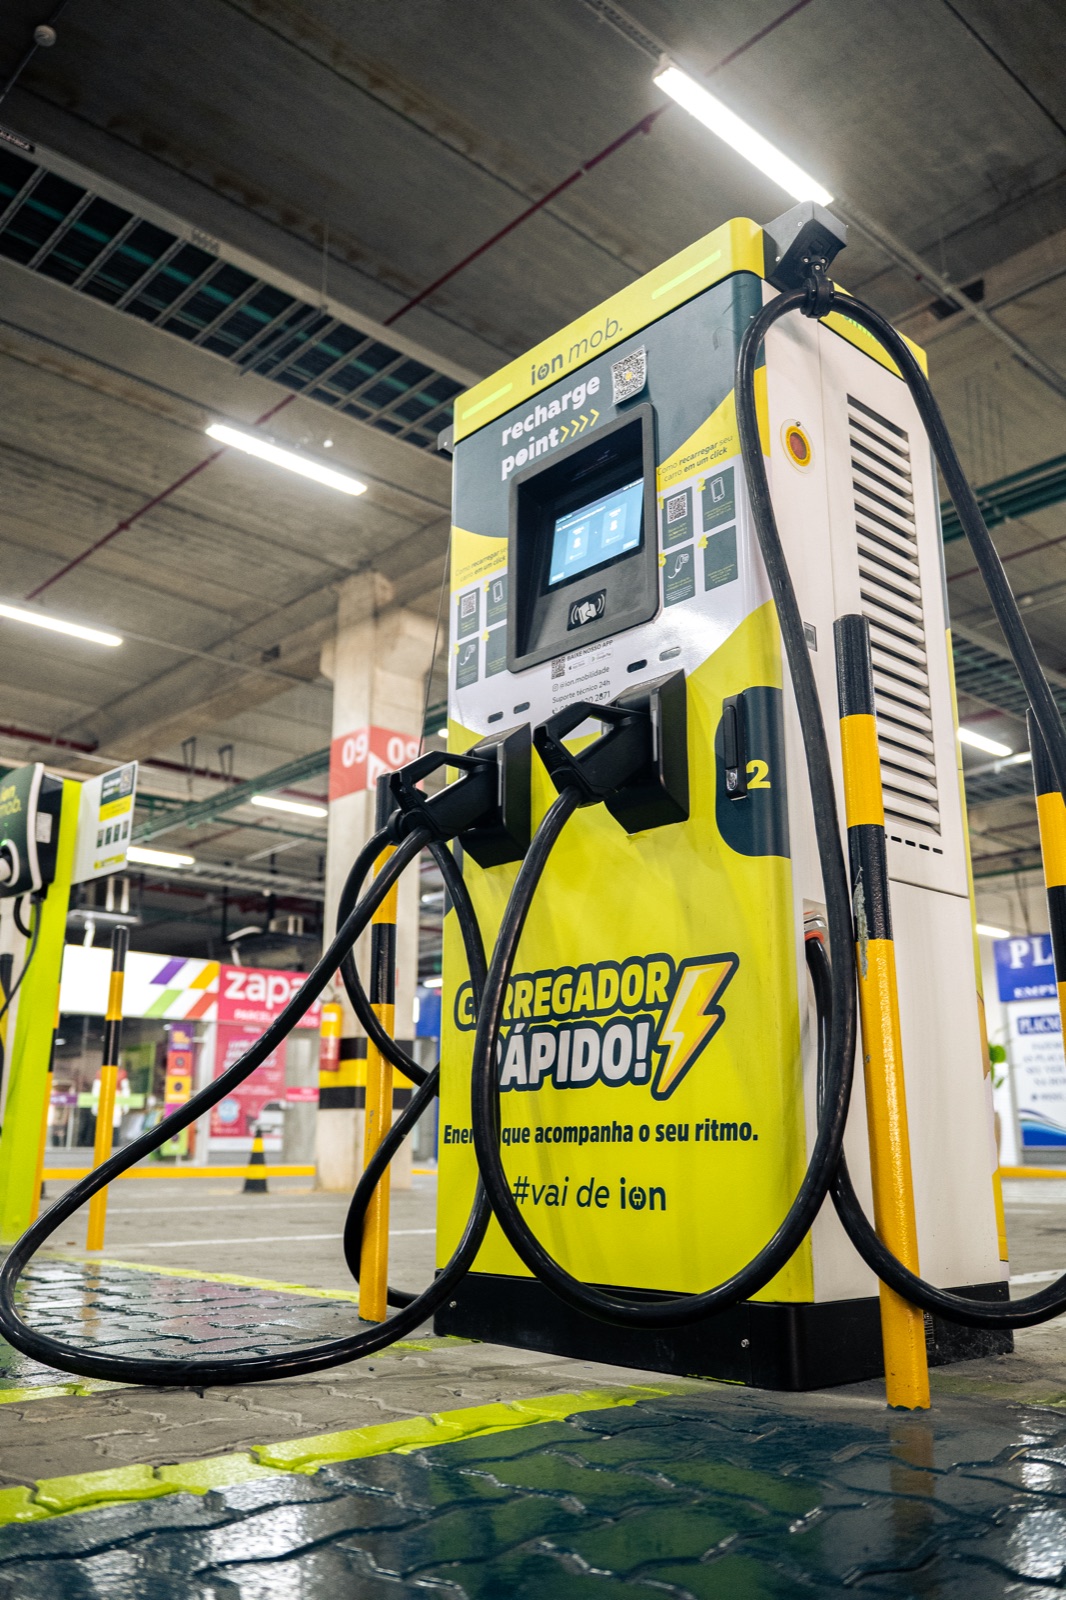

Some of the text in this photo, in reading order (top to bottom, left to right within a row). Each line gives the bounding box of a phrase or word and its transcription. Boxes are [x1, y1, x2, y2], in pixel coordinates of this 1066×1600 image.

[531, 317, 623, 386] ion mob.
[502, 376, 600, 447] recharge
[501, 427, 559, 482] point
[657, 435, 733, 476] Como recarregar seu
[664, 446, 728, 482] carro em um click
[657, 496, 664, 510] 1
[697, 478, 706, 492] 2
[697, 534, 708, 549] 4
[567, 651, 582, 662] BAIXE
[583, 644, 601, 654] NOSSO
[602, 640, 613, 648] APP
[552, 680, 611, 704] Suporte técnico 24h
[341, 733, 368, 768] 09
[745, 760, 771, 790] 2
[224, 970, 322, 1013] zapa
[456, 959, 672, 1026] CRREGADOR
[496, 1021, 650, 1087] ÁPIDO!
[444, 1118, 759, 1147] Ener que acompanha o seu ritmo.
[512, 1175, 667, 1211] #vai de ion
